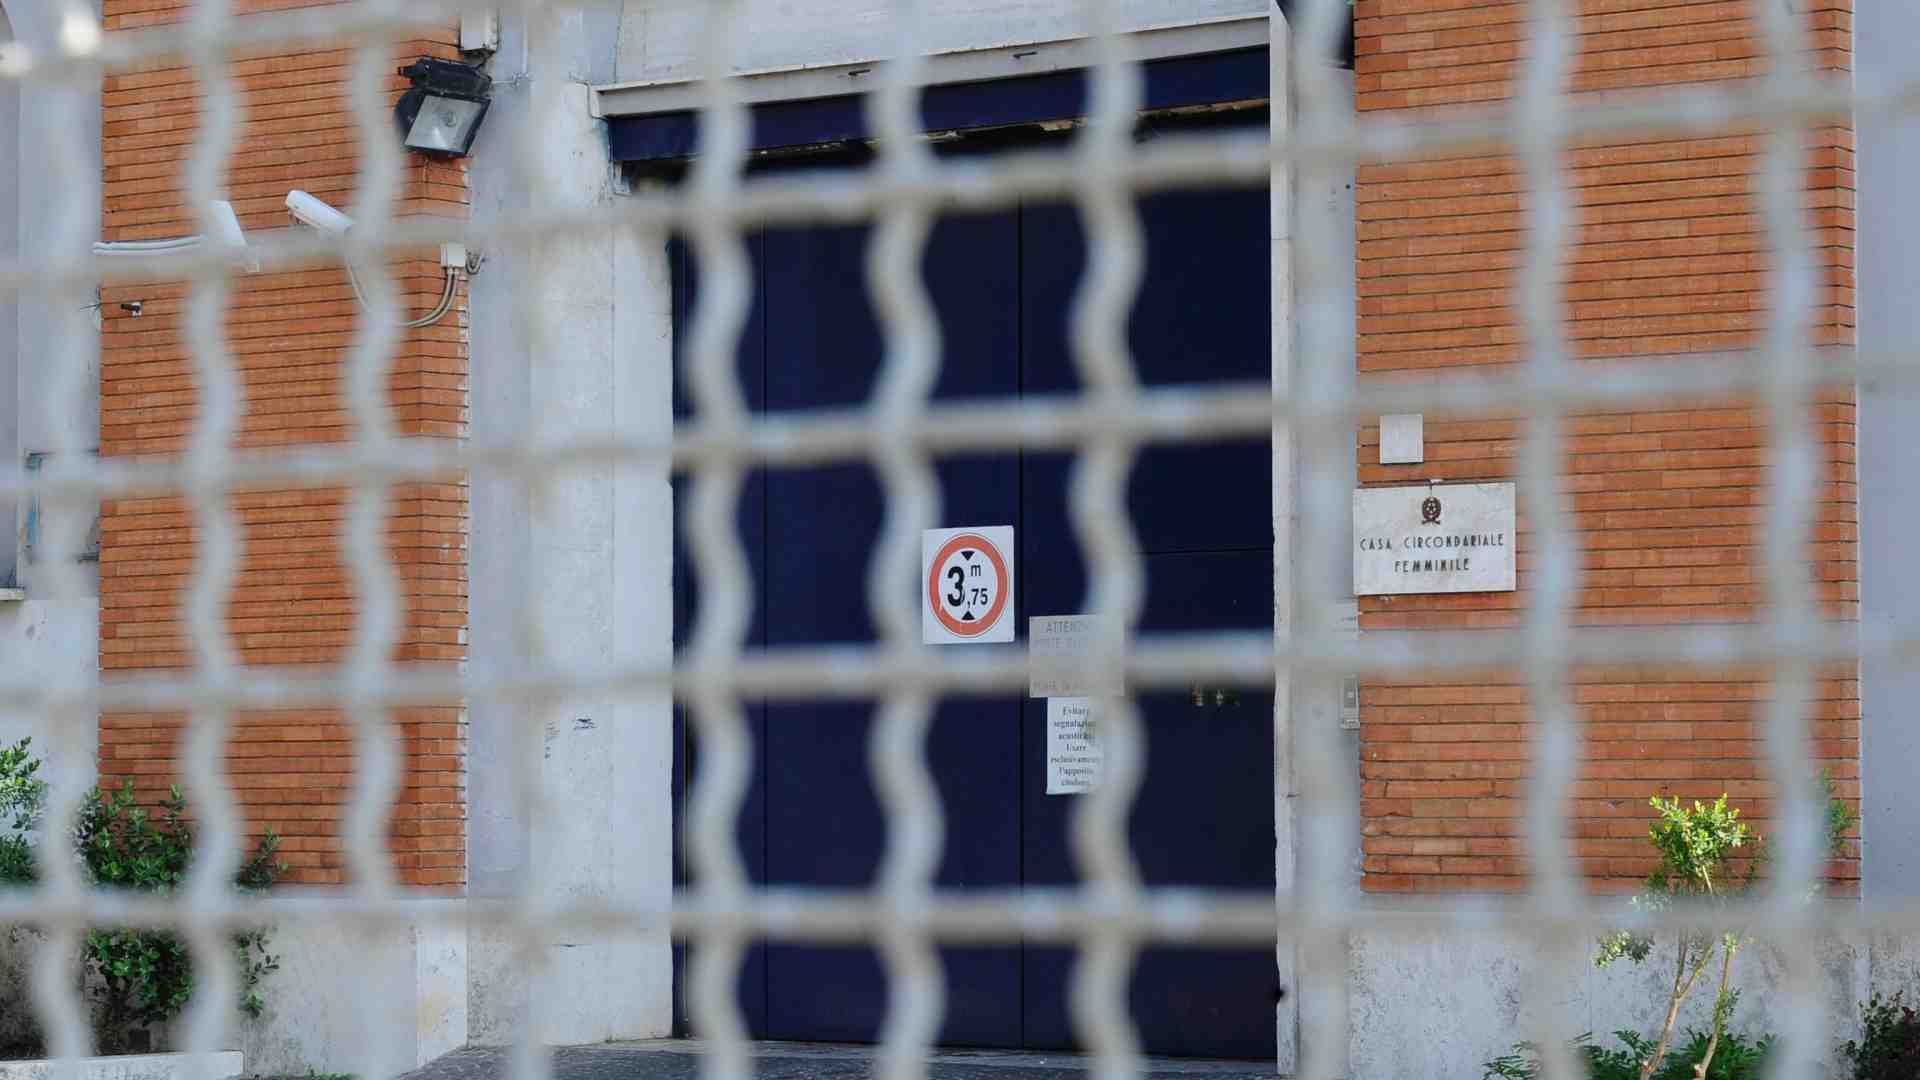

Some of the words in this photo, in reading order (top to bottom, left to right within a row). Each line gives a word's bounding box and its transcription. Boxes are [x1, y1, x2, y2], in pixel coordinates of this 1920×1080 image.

[1359, 538, 1392, 551] CASA
[1404, 533, 1505, 549] CIRCONDARIALE
[970, 564, 981, 577] m
[1394, 558, 1470, 573] FEMMINILE
